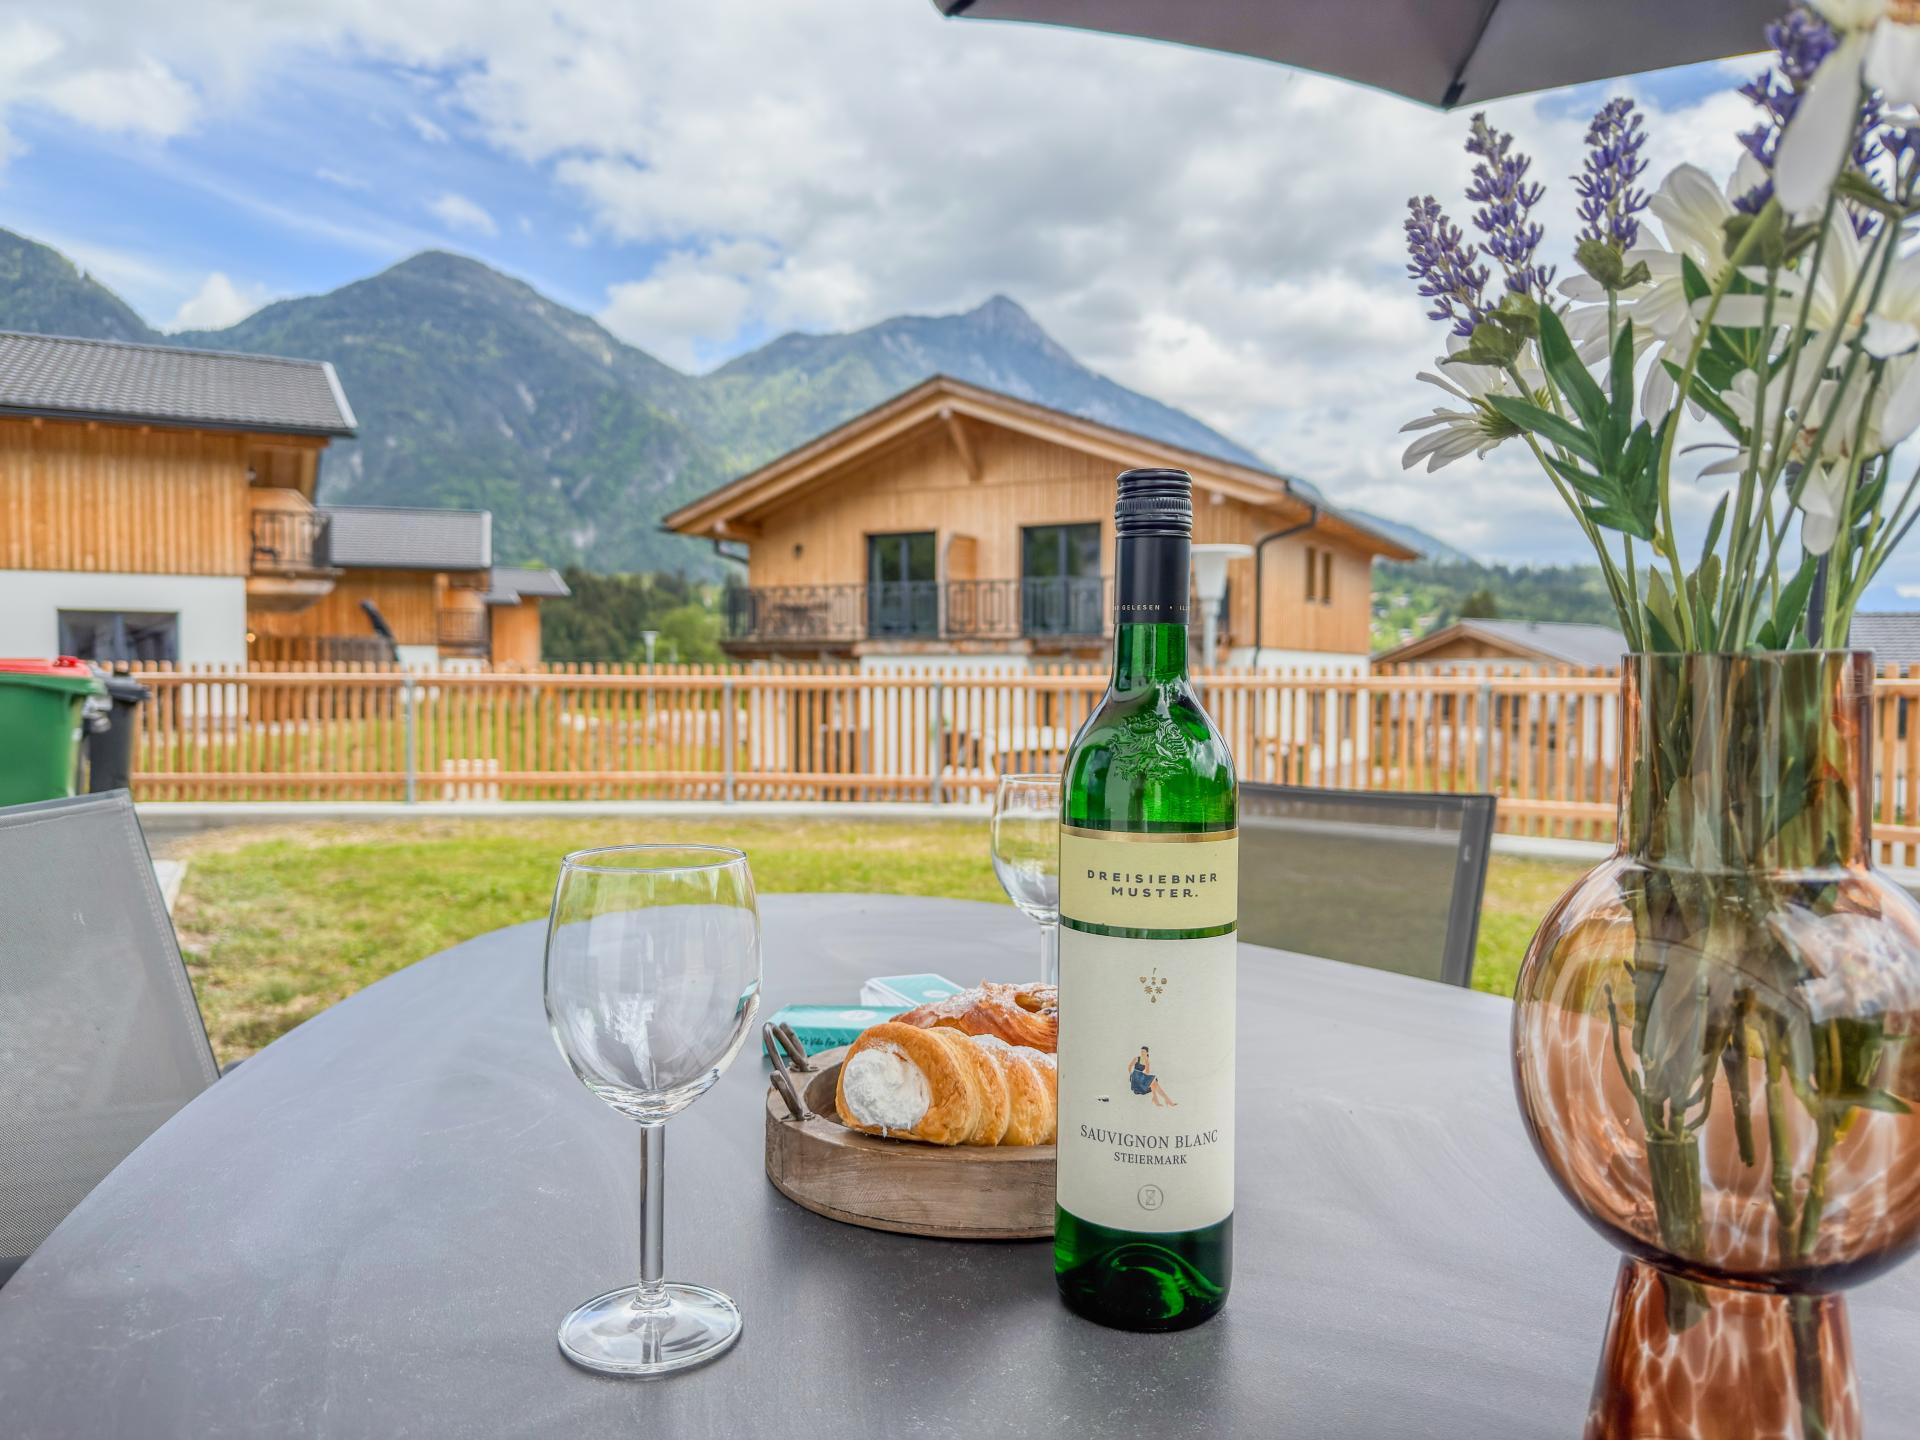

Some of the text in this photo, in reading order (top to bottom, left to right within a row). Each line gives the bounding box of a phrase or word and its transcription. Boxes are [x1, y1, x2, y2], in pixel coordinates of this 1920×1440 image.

[1087, 869, 1217, 884] DREISIEBNER
[1111, 886, 1198, 898] MUSTER.
[1080, 1124, 1218, 1149] SAUVIGNON BLANC
[1113, 1151, 1188, 1165] STEIERMARK
